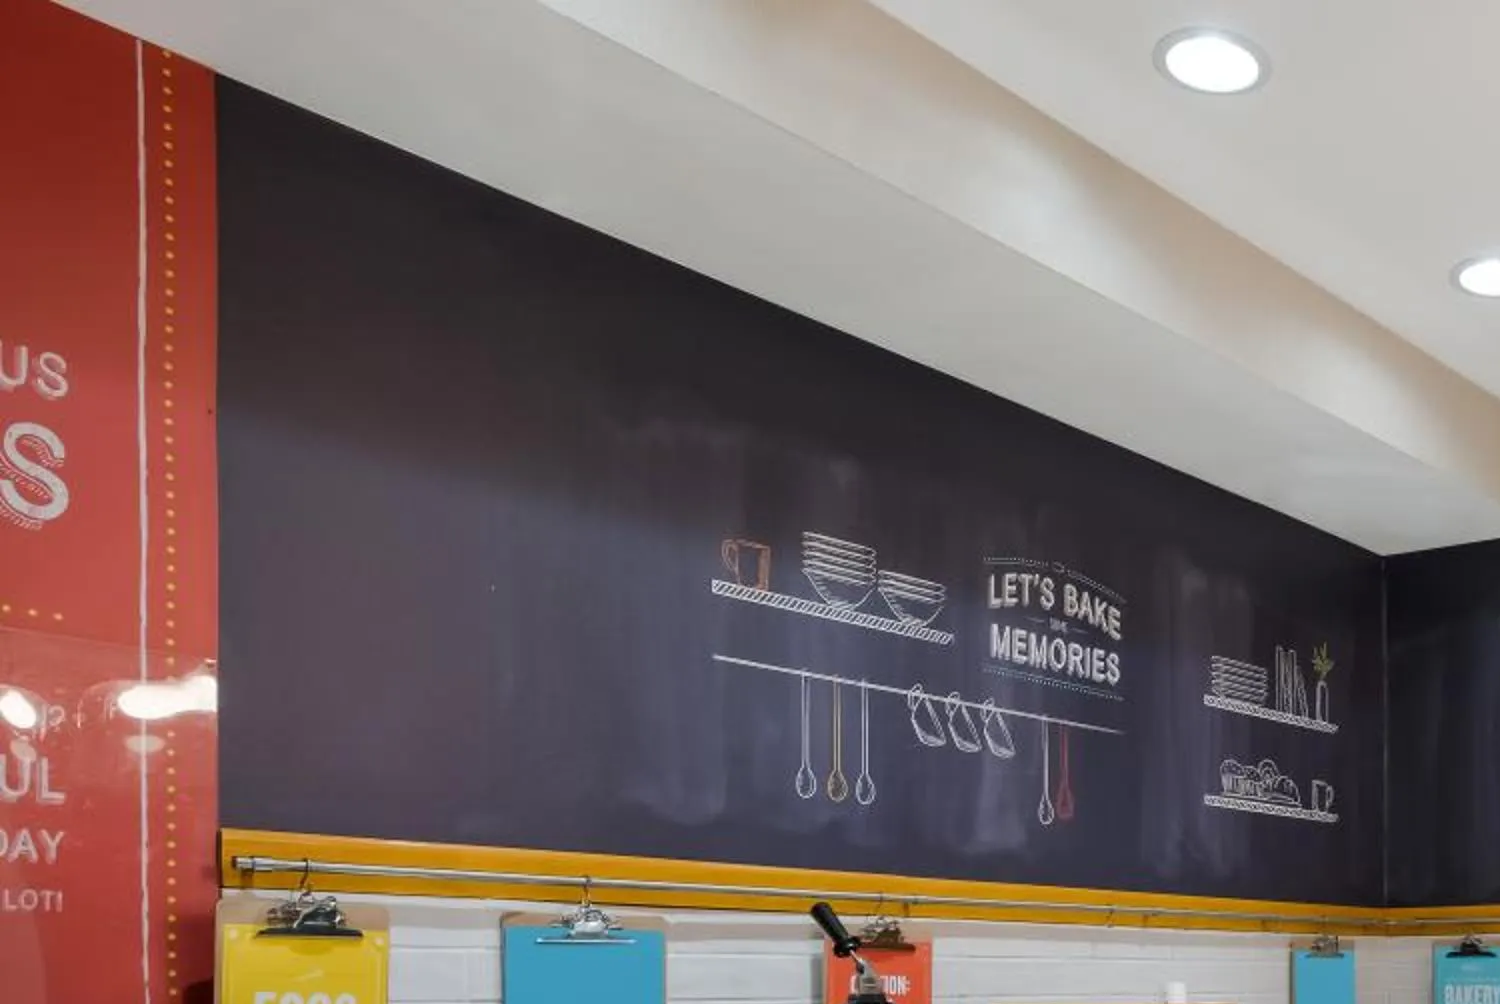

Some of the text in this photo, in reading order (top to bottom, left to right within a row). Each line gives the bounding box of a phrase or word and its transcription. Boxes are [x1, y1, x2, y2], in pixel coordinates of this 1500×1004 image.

[988, 572, 1055, 611] LET'S
[1063, 583, 1122, 641] BAKE
[990, 623, 1121, 686] MEMORIES
